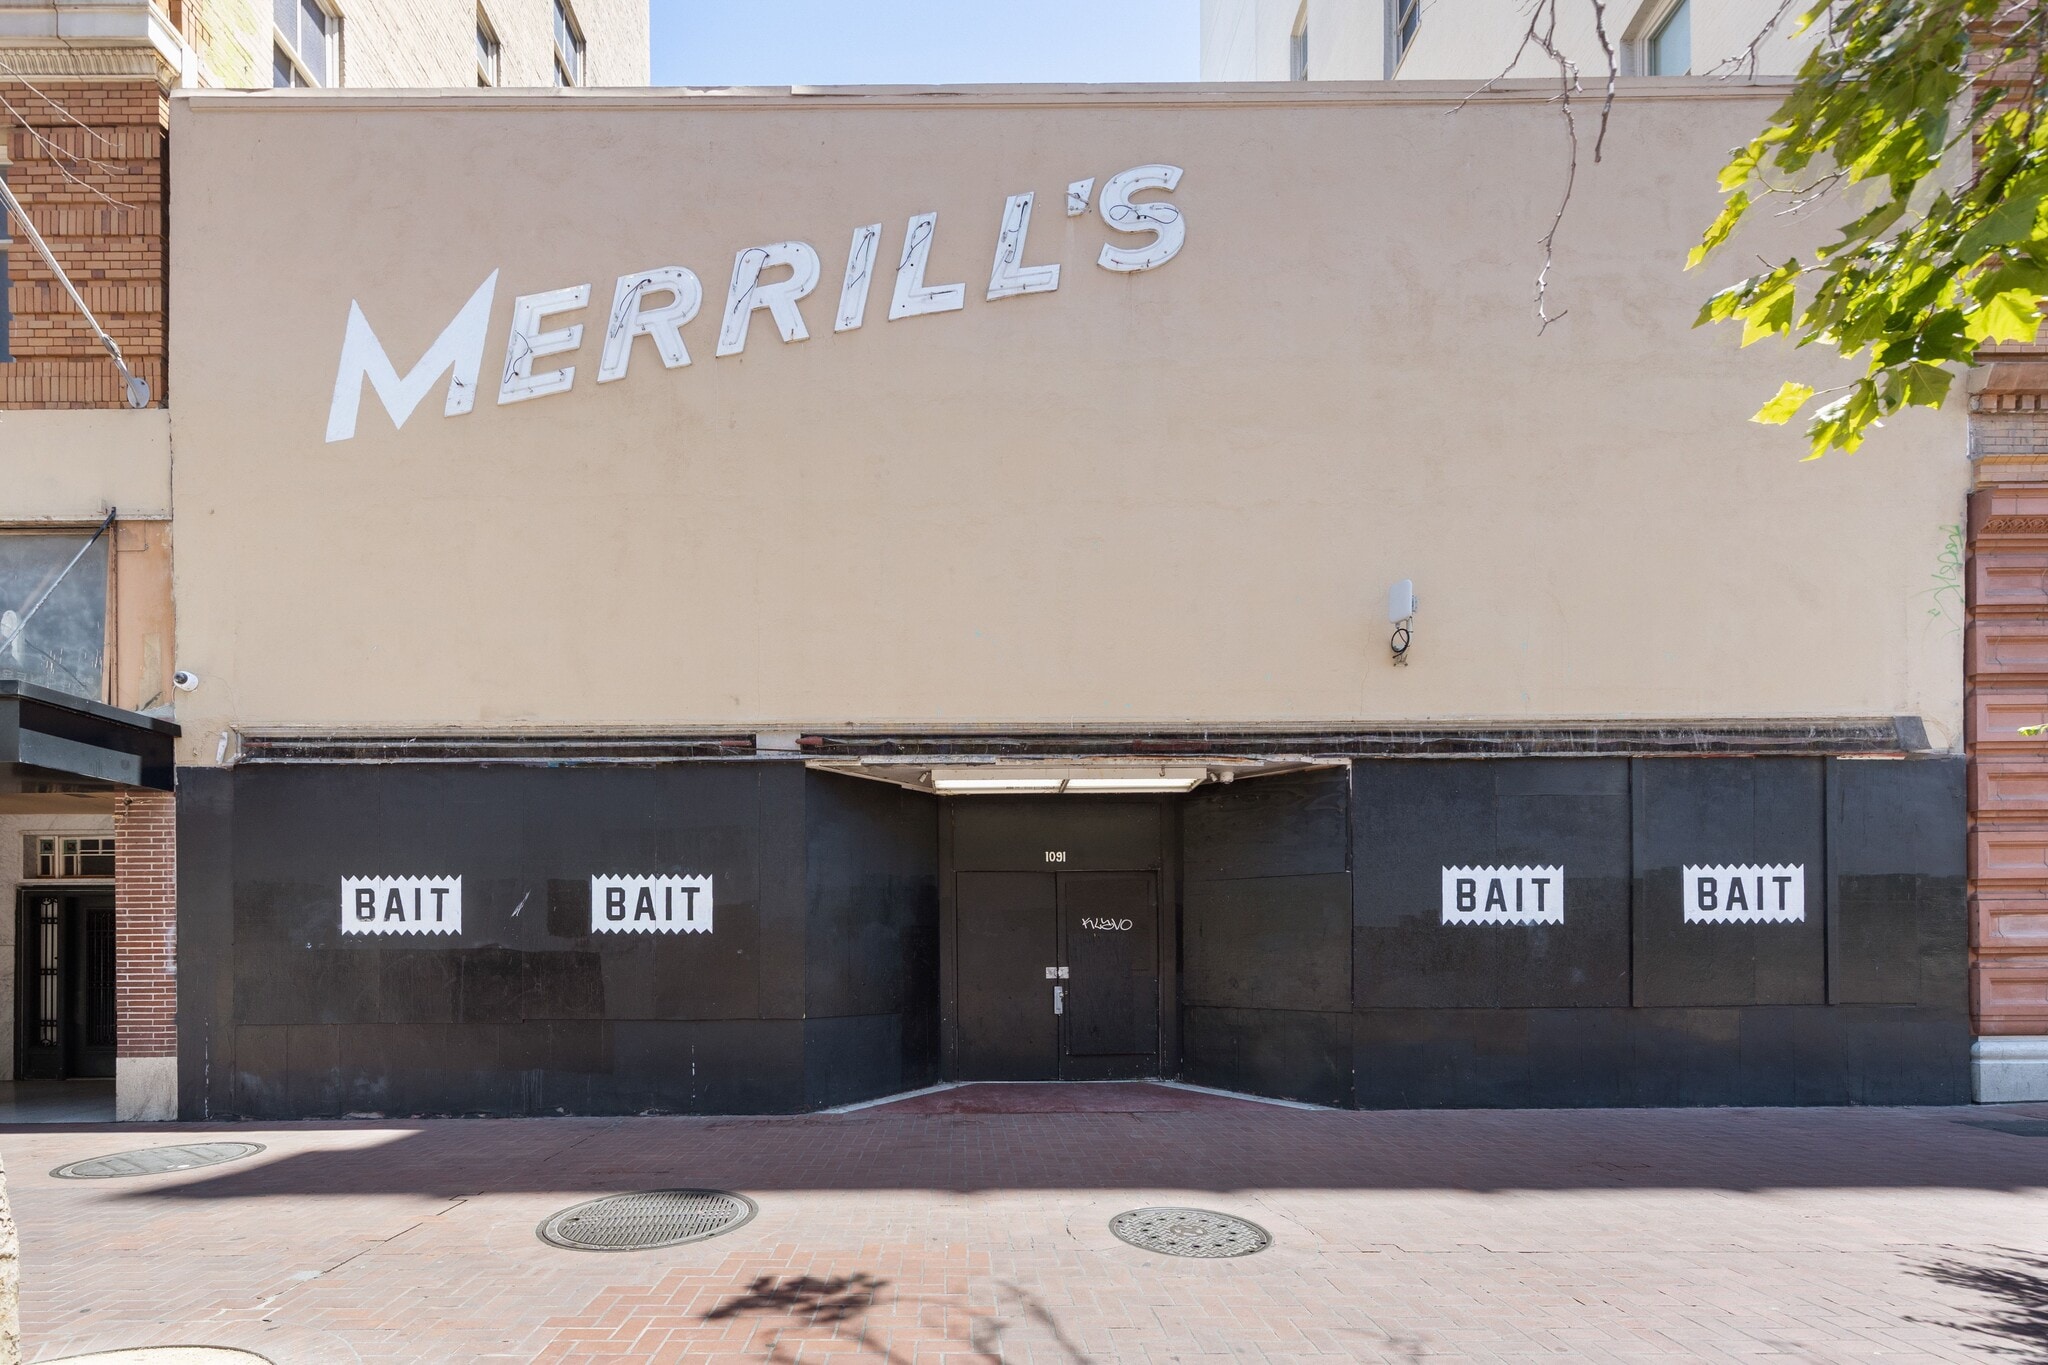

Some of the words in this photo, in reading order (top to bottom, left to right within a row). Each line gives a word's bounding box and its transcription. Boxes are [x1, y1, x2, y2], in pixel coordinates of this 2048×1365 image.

[325, 163, 1187, 443] MERRILL'S
[1045, 851, 1066, 863] 1091
[355, 887, 450, 922] BAIT
[605, 886, 701, 921] BAIT
[1456, 877, 1551, 912] BAIT
[1697, 876, 1792, 911] BAIT
